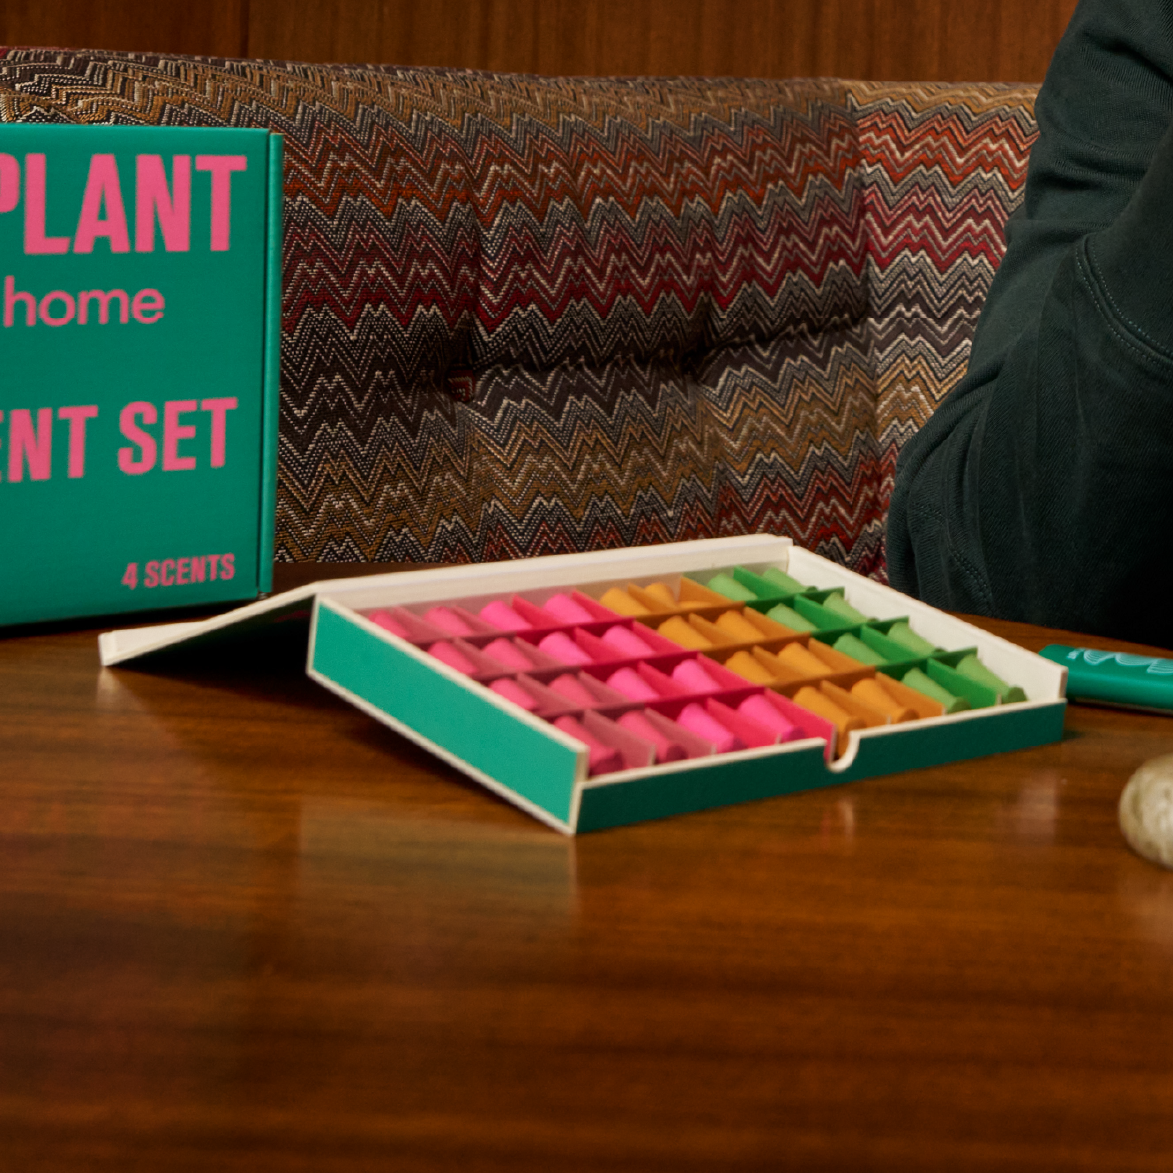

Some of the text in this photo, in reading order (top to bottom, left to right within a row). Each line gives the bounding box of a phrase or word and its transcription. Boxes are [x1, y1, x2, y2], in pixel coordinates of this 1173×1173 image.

[4, 276, 165, 327] home
[0, 397, 238, 483] NT SET
[122, 553, 235, 590] 4 SCENTS
